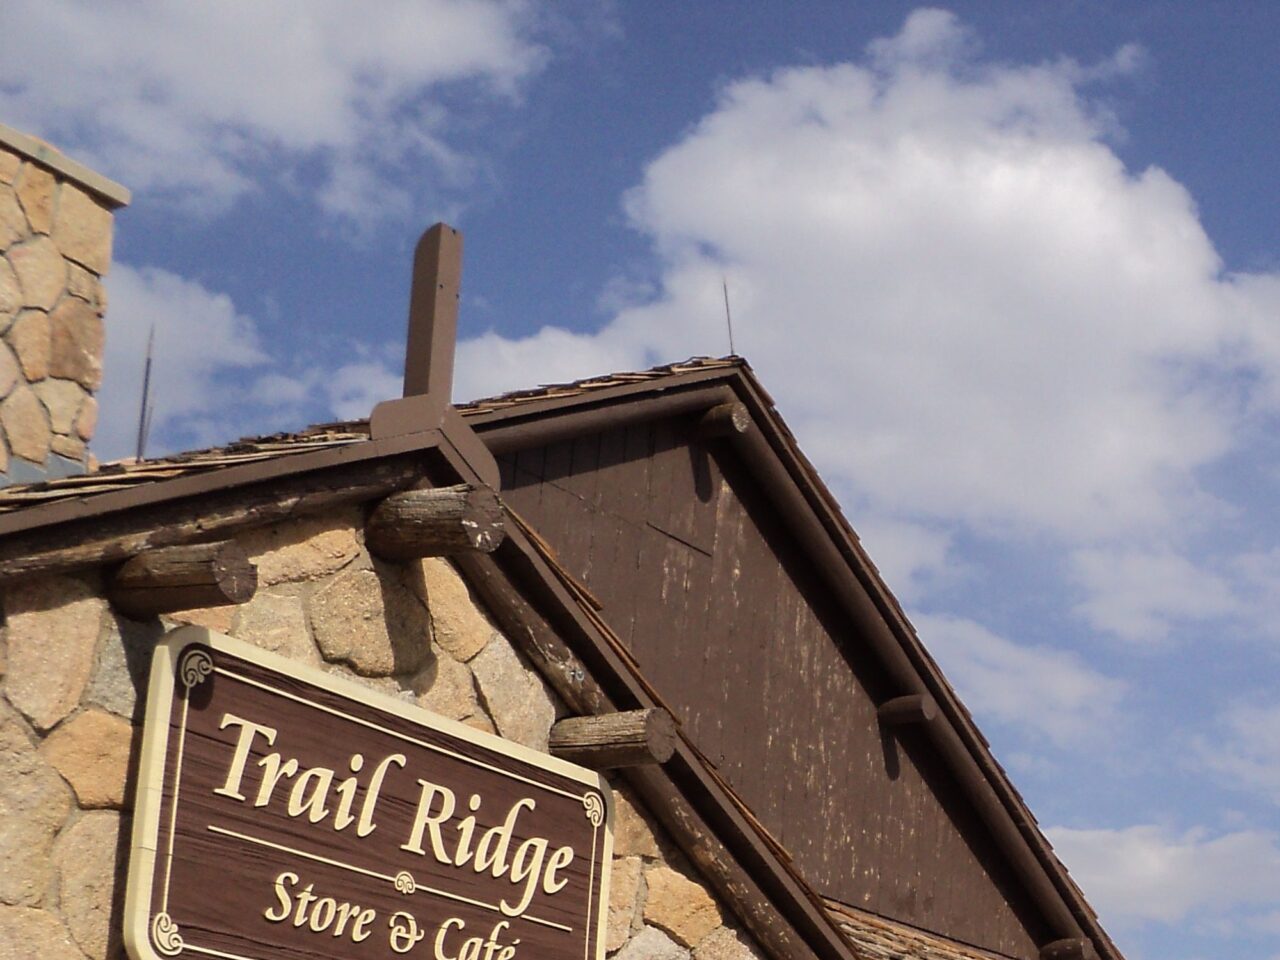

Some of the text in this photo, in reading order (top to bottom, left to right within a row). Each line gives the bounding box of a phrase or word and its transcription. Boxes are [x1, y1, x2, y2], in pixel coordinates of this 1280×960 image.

[214, 713, 574, 917] Trail Ridge
[265, 872, 376, 942] Store
[389, 911, 425, 953] &
